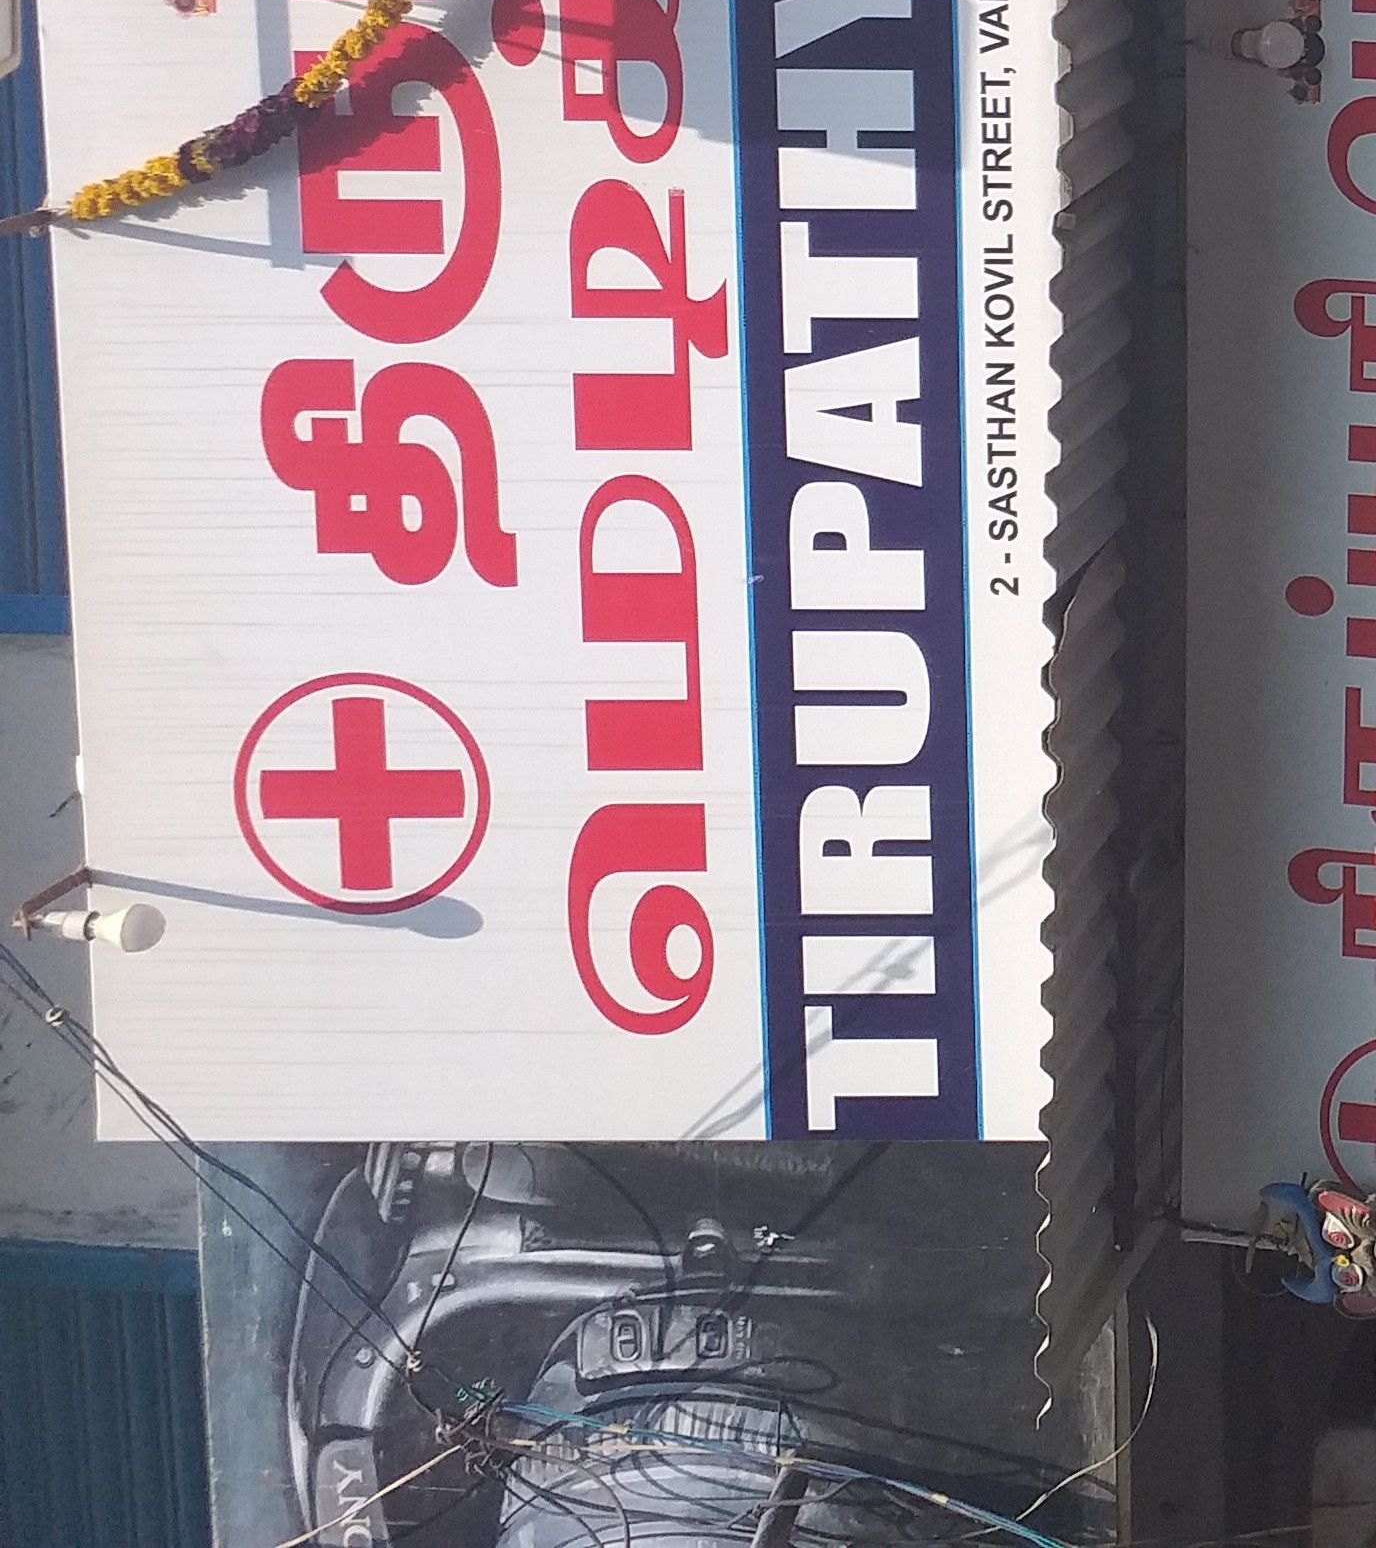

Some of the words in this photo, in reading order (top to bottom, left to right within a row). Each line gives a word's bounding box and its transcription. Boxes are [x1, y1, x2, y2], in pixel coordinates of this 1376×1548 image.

[979, 64, 1018, 223] STREET,
[983, 232, 1016, 348] KOVIL
[985, 361, 1019, 543] SASTHAN
[989, 576, 1019, 597] 2
